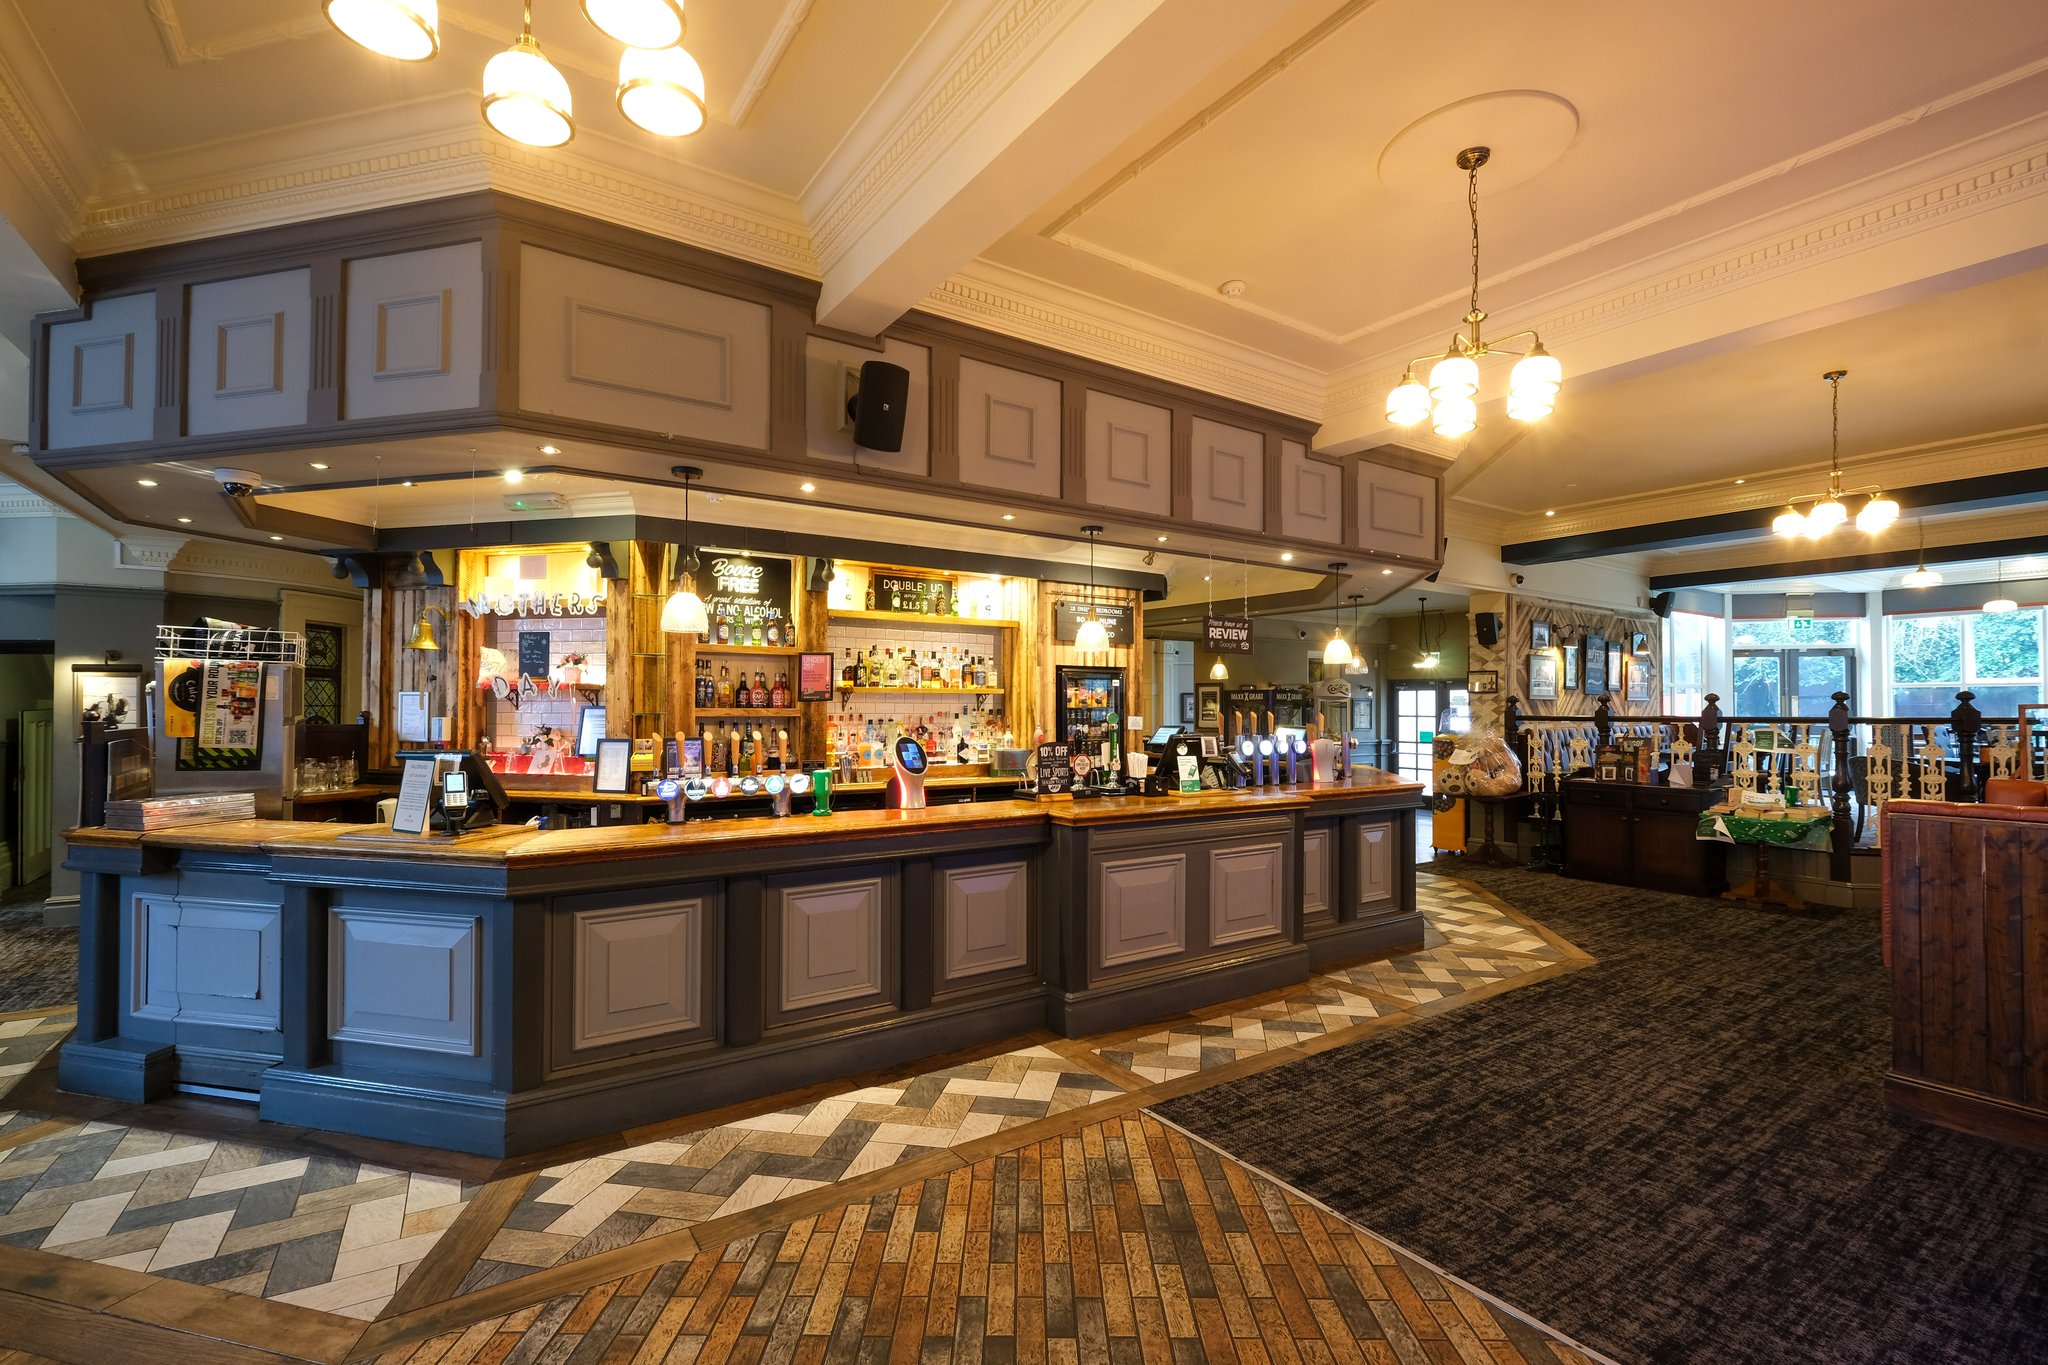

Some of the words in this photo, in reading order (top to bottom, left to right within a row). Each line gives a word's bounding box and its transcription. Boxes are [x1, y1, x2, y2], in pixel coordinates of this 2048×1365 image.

[712, 558, 764, 578] Booze
[718, 576, 759, 594] FREE
[744, 606, 783, 618] ALCOHOL
[1209, 627, 1248, 640] REVIEW
[1219, 641, 1237, 649] Google
[208, 660, 220, 678] ROUN
[206, 680, 218, 699] YOUR
[492, 673, 560, 698] DAY
[206, 701, 216, 712] ON
[203, 713, 216, 744] RESULTS
[1040, 746, 1053, 757] 10%
[1055, 746, 1068, 756] OFF
